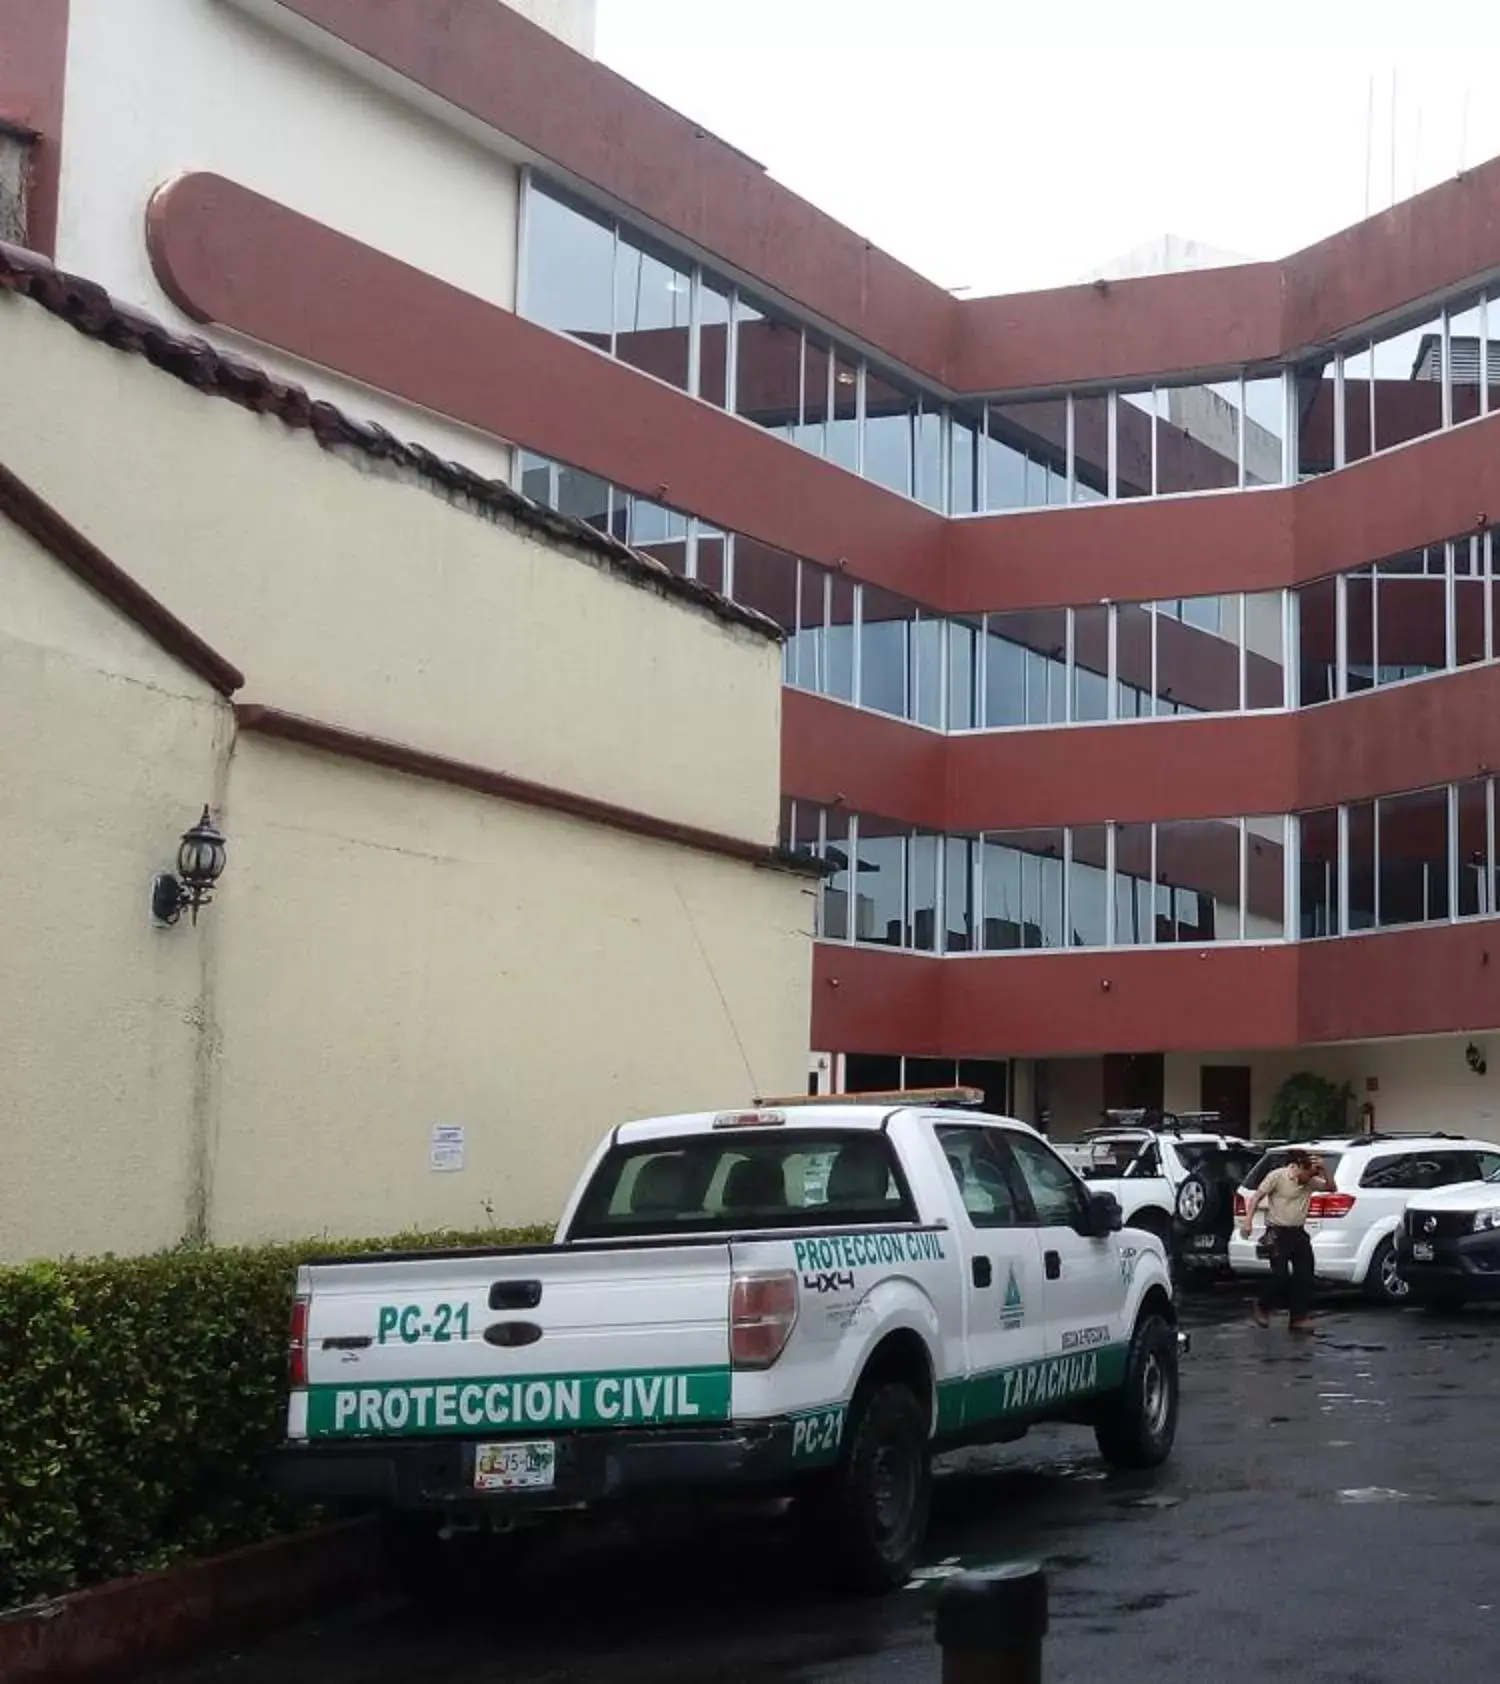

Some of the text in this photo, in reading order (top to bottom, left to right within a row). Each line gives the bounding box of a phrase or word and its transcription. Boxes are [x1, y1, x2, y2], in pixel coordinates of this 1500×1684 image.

[794, 1233, 945, 1271] PROTECCION CIVIL
[378, 1302, 470, 1344] PC-21
[335, 1375, 700, 1430] PROTECCION CIVIL
[1002, 1352, 1098, 1409] TAPACHULA
[791, 1408, 844, 1457] PC-21
